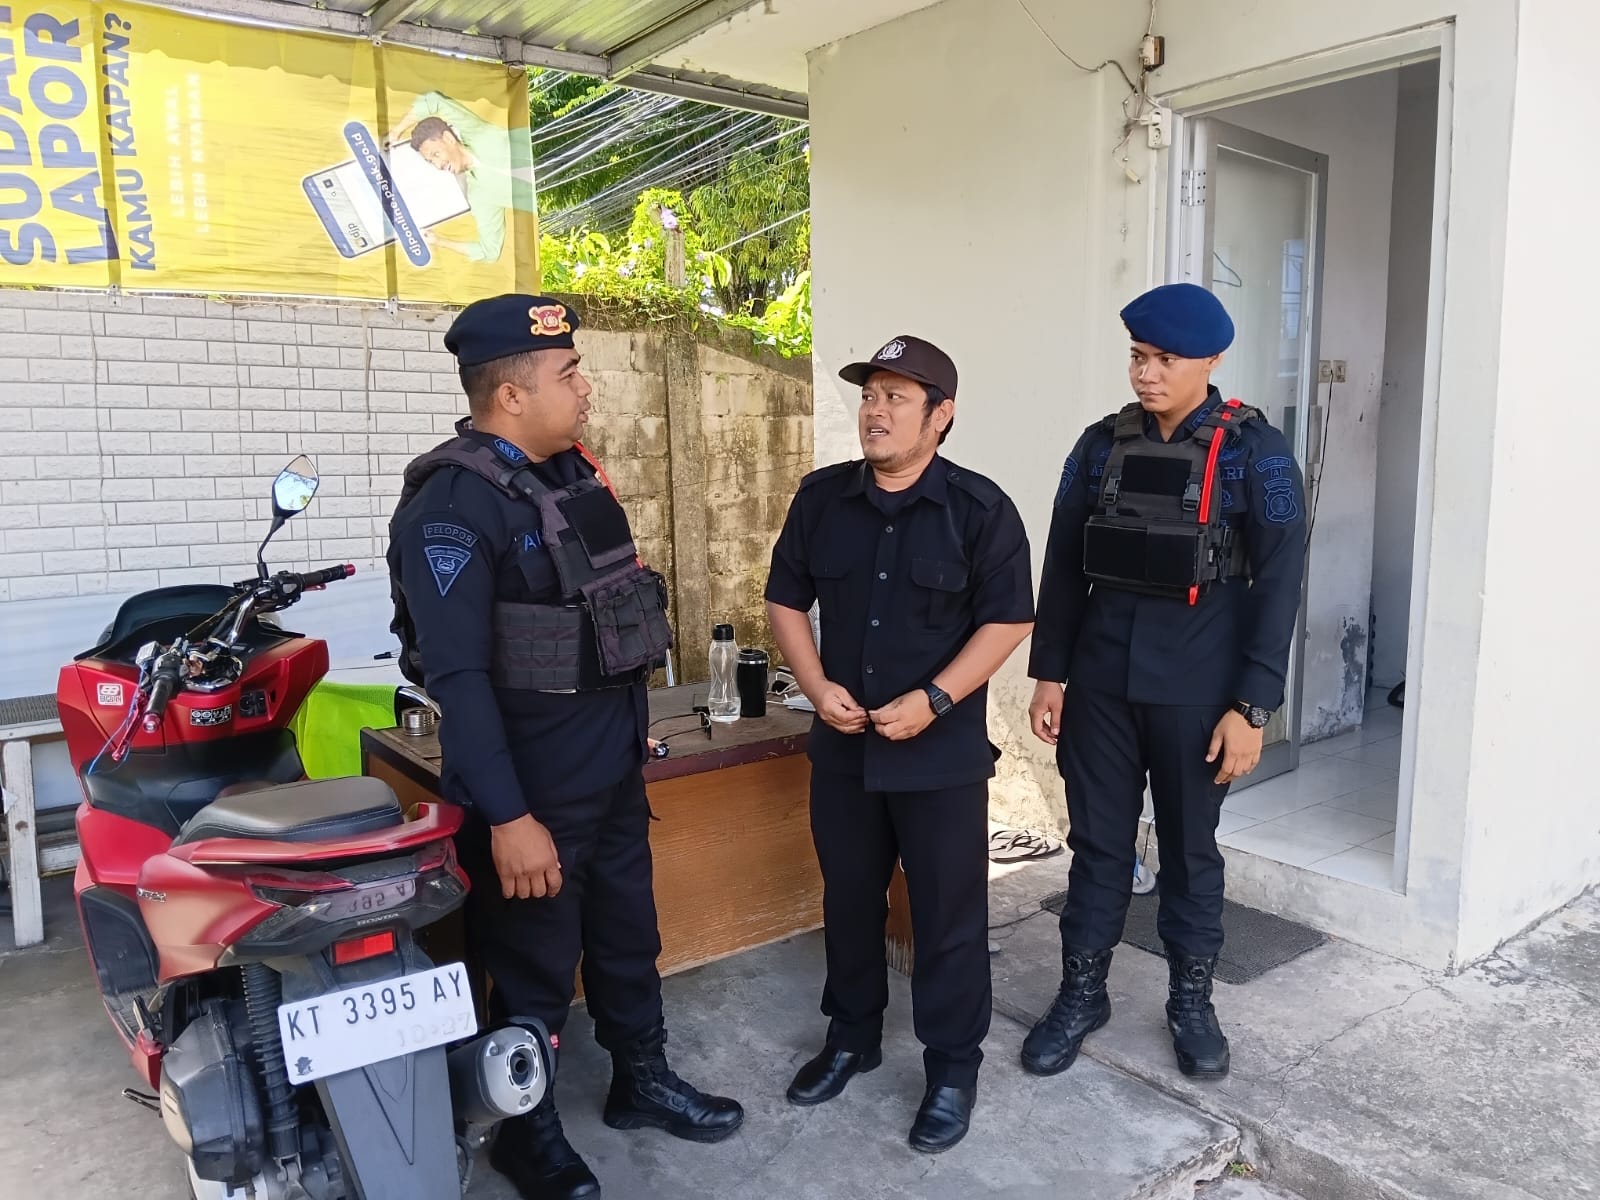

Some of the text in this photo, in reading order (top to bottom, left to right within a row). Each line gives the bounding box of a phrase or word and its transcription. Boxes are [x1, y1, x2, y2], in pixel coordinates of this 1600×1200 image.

[0, 6, 56, 265] SUD
[24, 13, 119, 264] LAPOR
[102, 13, 155, 270] KAMU KAPAN?
[168, 156, 185, 217] LEBIH
[192, 172, 208, 232] LEBIH
[352, 132, 421, 256] djponline.pajak.go.id
[427, 527, 473, 543] PELOPOR
[287, 970, 460, 1041] KT 3395 AY
